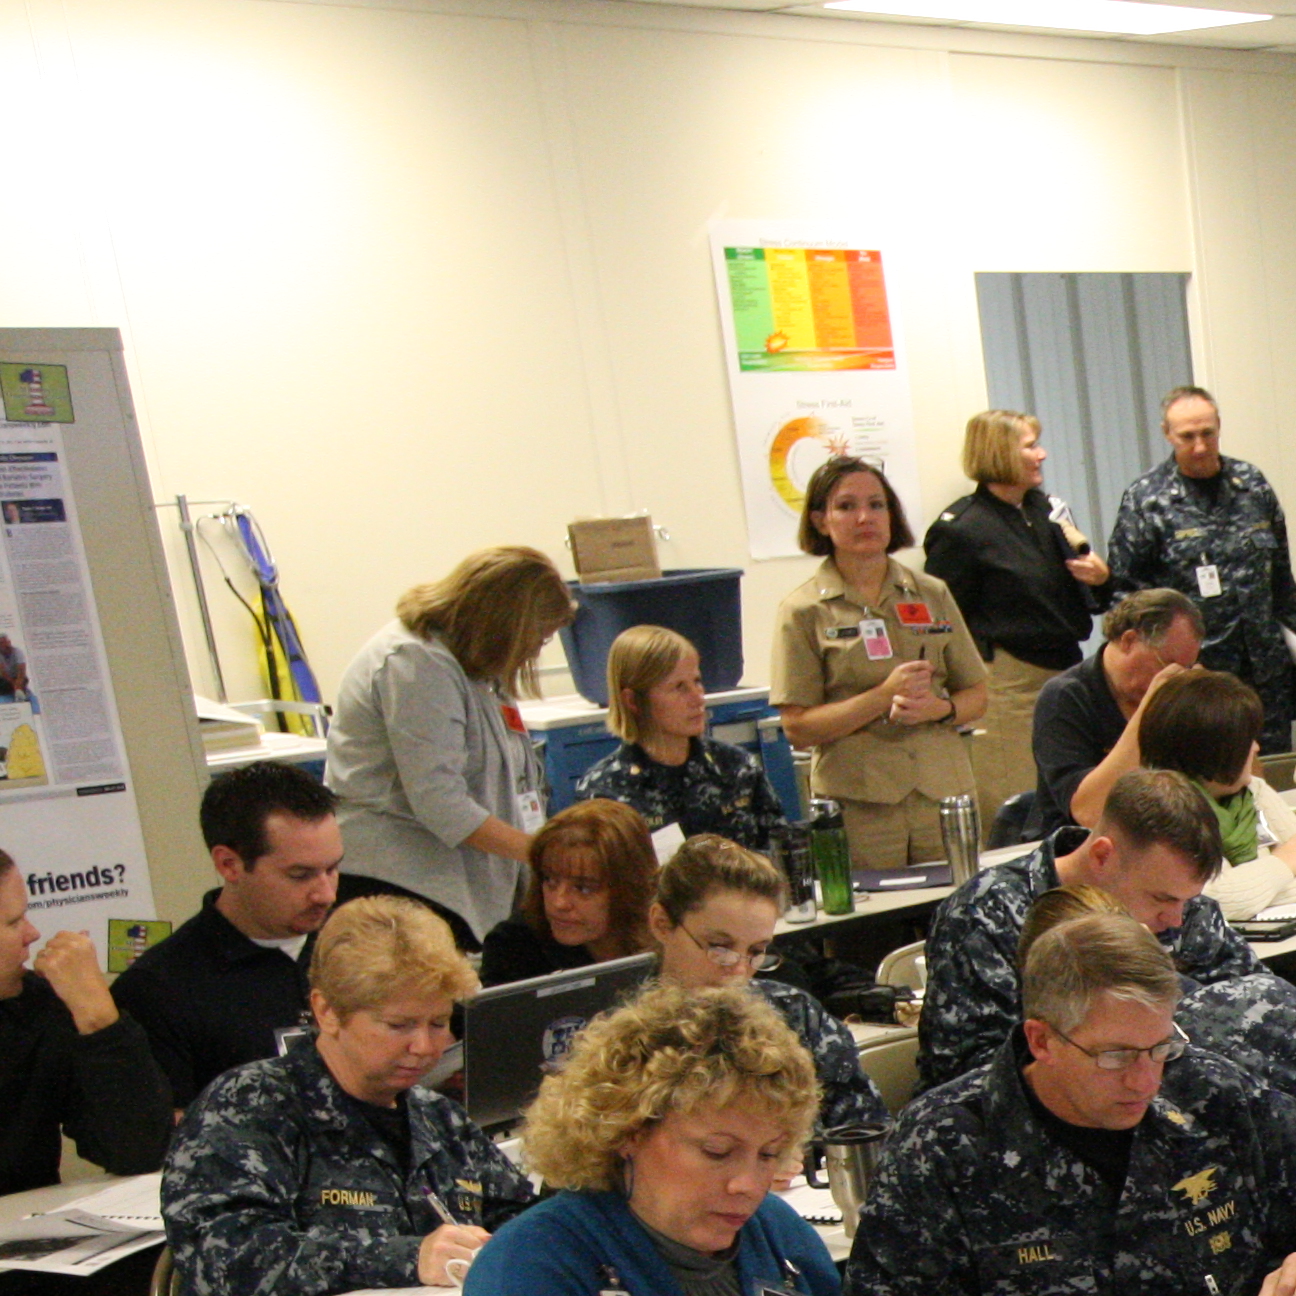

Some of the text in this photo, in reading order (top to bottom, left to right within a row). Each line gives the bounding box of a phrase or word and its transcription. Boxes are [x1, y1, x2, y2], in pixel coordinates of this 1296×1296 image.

[27, 864, 126, 896] friends?
[321, 1189, 374, 1207] FORMAN
[1184, 1200, 1236, 1237] U.S. NAVY
[1017, 1245, 1054, 1265] HALL
